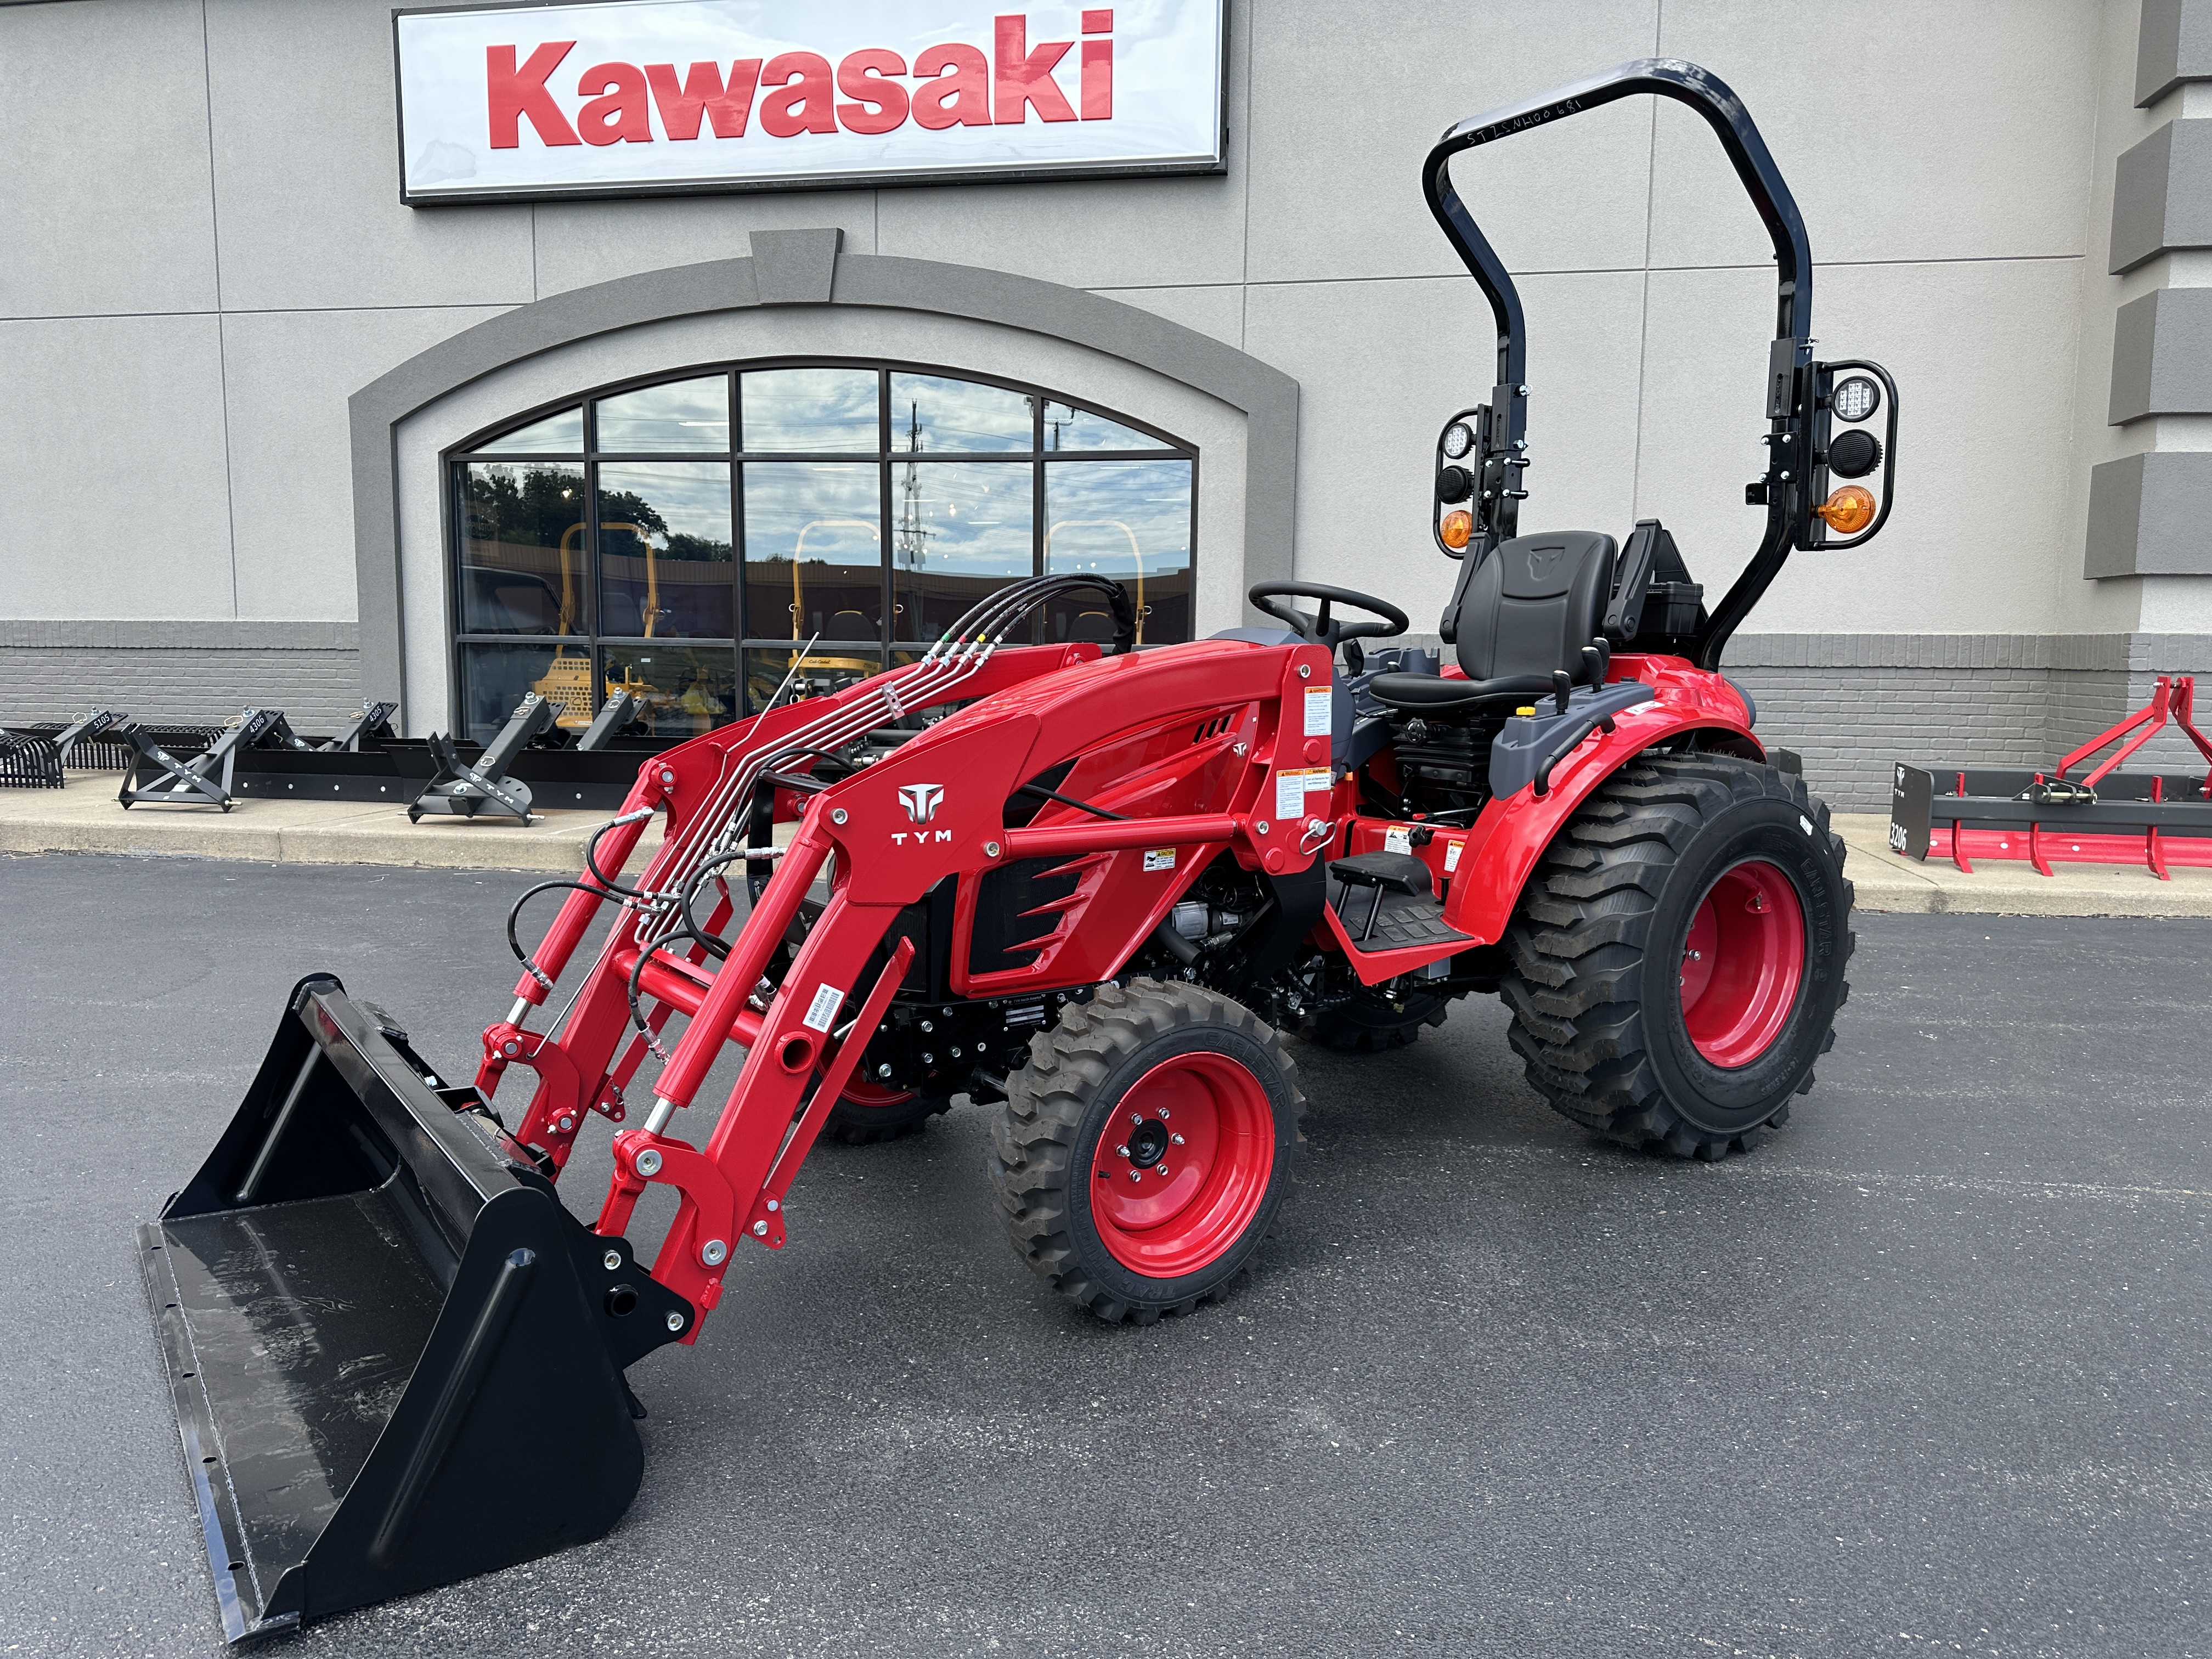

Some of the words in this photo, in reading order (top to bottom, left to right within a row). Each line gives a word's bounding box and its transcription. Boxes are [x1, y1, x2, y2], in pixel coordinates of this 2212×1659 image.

[486, 8, 1113, 149] Kawasaki
[94, 714, 110, 729] 5105
[250, 715, 264, 733] 4306
[369, 706, 381, 722] 4305
[174, 763, 201, 782] TYM
[486, 783, 514, 804] TYM
[1894, 788, 1905, 798] TYM
[891, 830, 952, 845] TYM
[1889, 822, 1908, 851] 3206
[1800, 857, 1832, 957] CARLSTAR
[1204, 1031, 1287, 1111] CARLSTAR
[1073, 1218, 1115, 1279] CHIEF
[1118, 1278, 1177, 1300] TRAC
